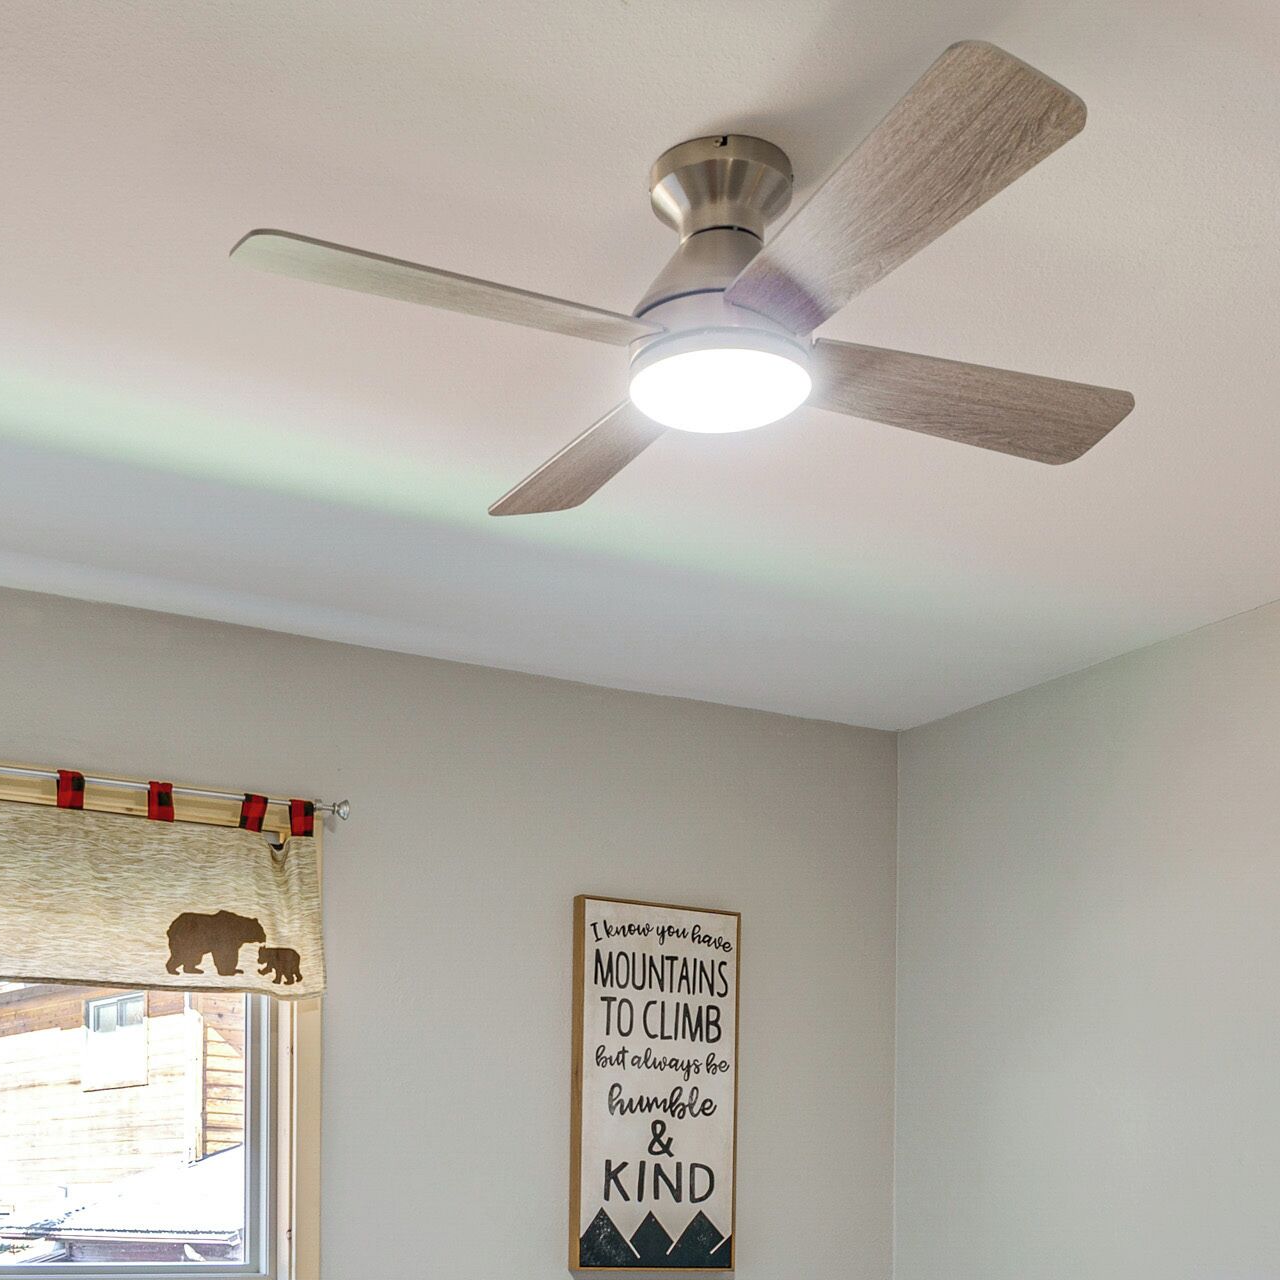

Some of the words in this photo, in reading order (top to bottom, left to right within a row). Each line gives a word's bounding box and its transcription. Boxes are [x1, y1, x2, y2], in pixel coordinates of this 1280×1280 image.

[590, 922, 603, 943] I
[603, 919, 655, 939] know
[656, 925, 690, 946] you
[691, 924, 733, 953] have
[593, 948, 729, 998] MOUNTAINS
[600, 996, 634, 1038] TO
[642, 1000, 722, 1044] CLIMB
[595, 1044, 629, 1071] but
[631, 1047, 703, 1082] always
[705, 1052, 730, 1075] be
[607, 1082, 718, 1120] humble
[647, 1119, 675, 1158] &
[603, 1159, 716, 1204] KIND
